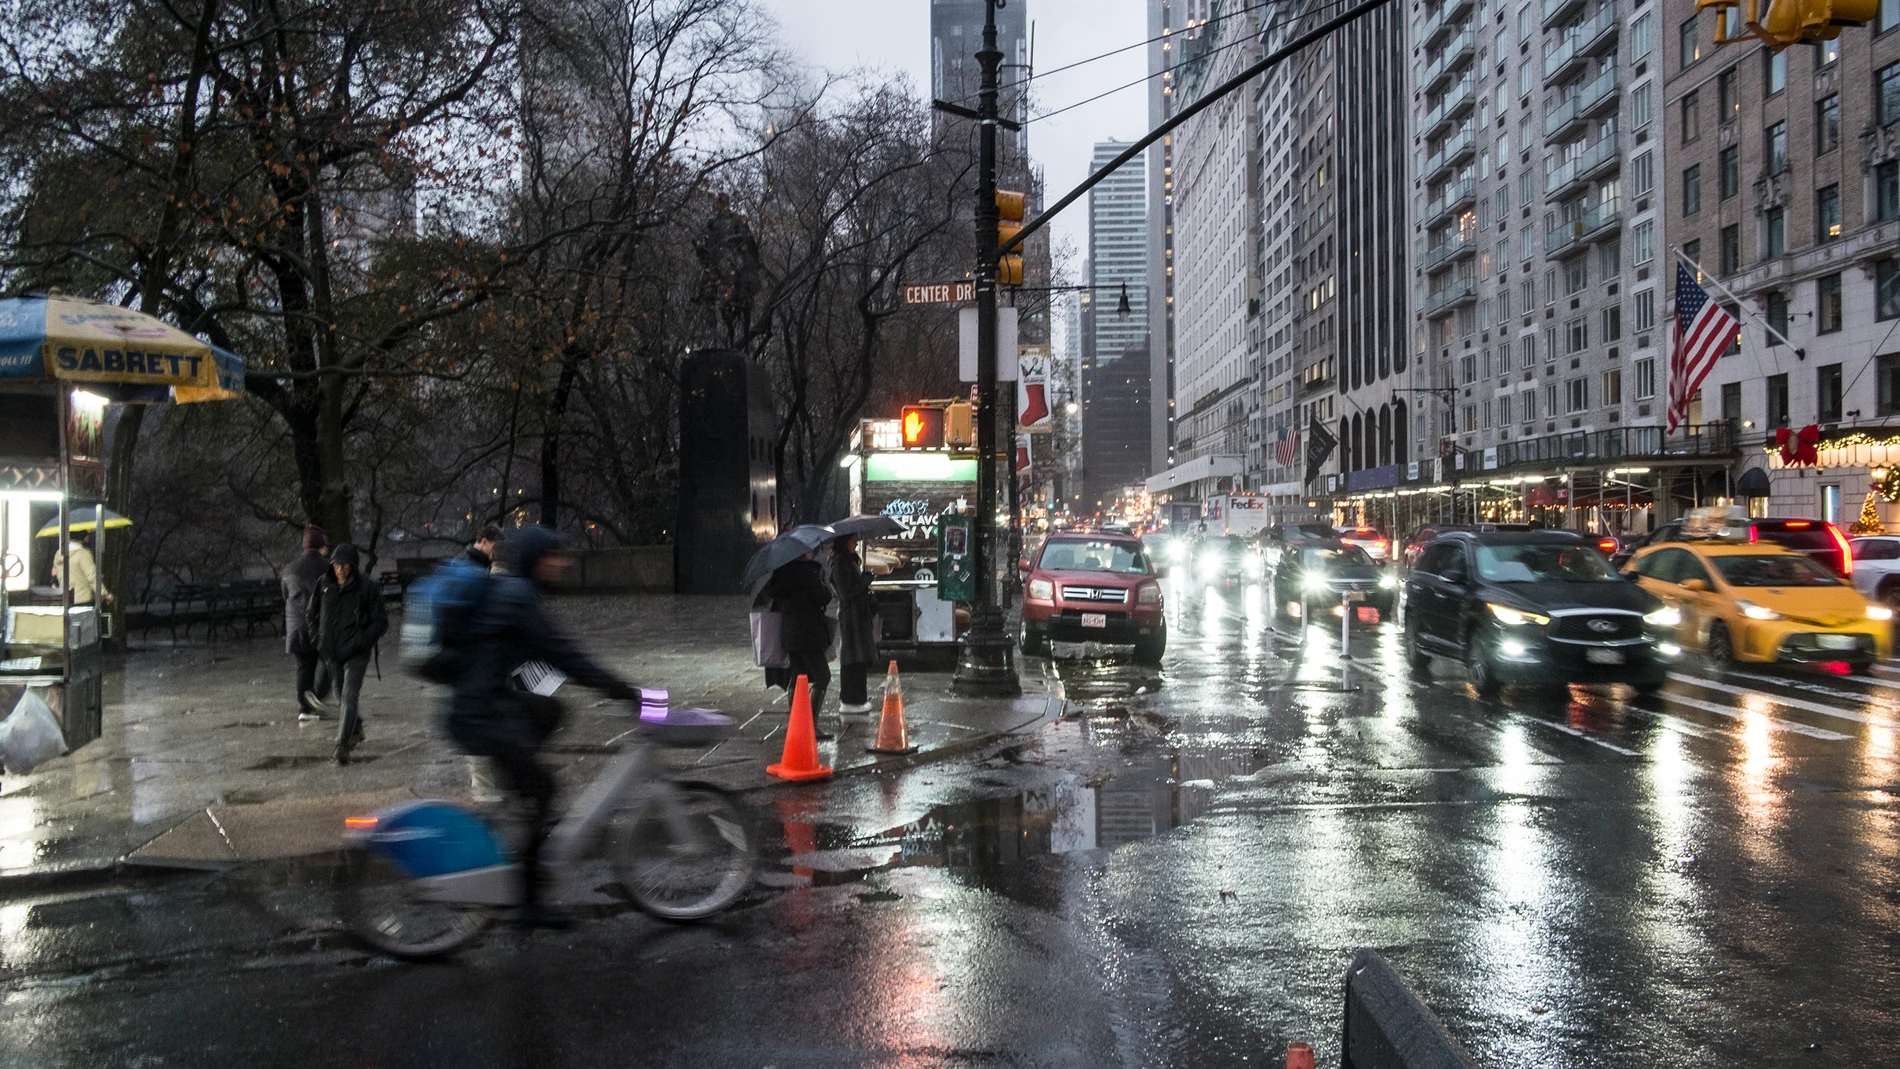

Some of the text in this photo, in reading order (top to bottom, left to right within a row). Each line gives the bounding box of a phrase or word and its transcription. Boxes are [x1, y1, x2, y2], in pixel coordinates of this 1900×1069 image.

[907, 284, 949, 304] CENTER
[57, 347, 203, 376] SABRETT
[1231, 498, 1264, 510] FedEx
